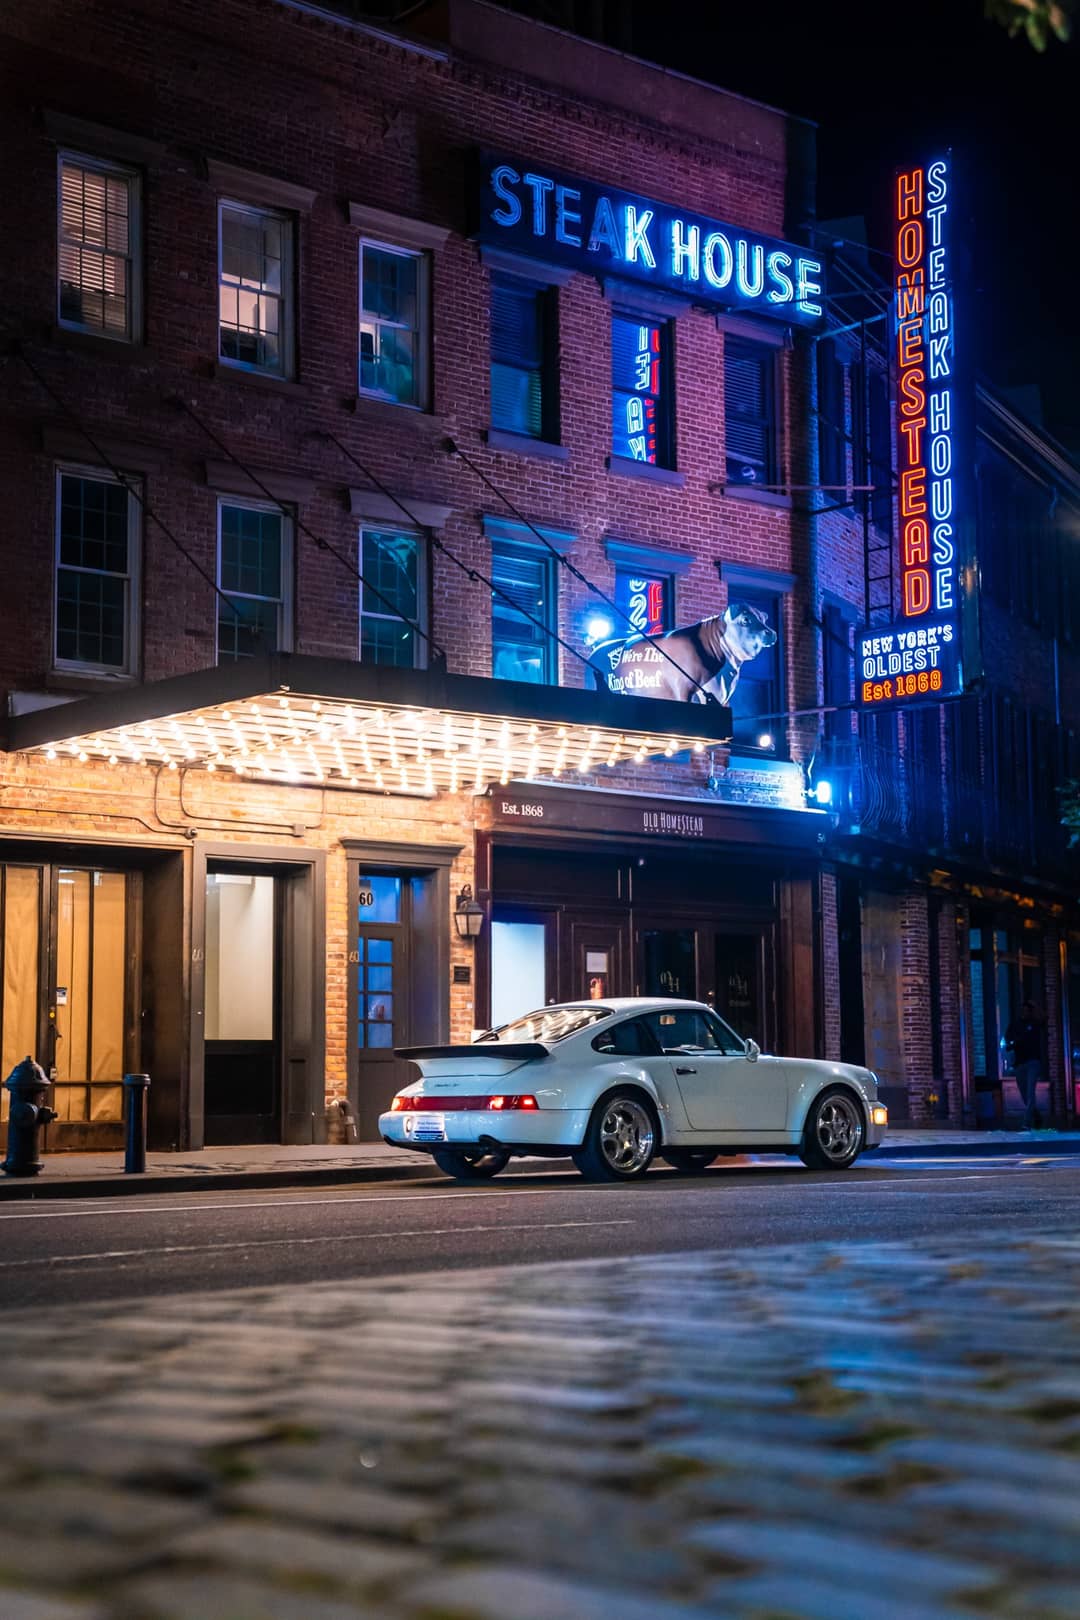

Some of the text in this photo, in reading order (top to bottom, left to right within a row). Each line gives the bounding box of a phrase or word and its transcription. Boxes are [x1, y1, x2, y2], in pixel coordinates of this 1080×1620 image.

[490, 165, 822, 316] STEAK HOUSE
[897, 168, 931, 616] HOMESTEAD
[926, 161, 953, 609] STEAK HOUSE
[643, 647, 664, 663] The
[862, 624, 953, 657] NEW YORK'S
[863, 645, 941, 679] OLDEST
[608, 669, 662, 691] King of Beef
[863, 669, 942, 702] Est 1868
[501, 801, 544, 817] Est. 1868
[643, 811, 658, 828] OLD
[660, 811, 704, 832] HOMESTEAD
[359, 892, 374, 906] 60
